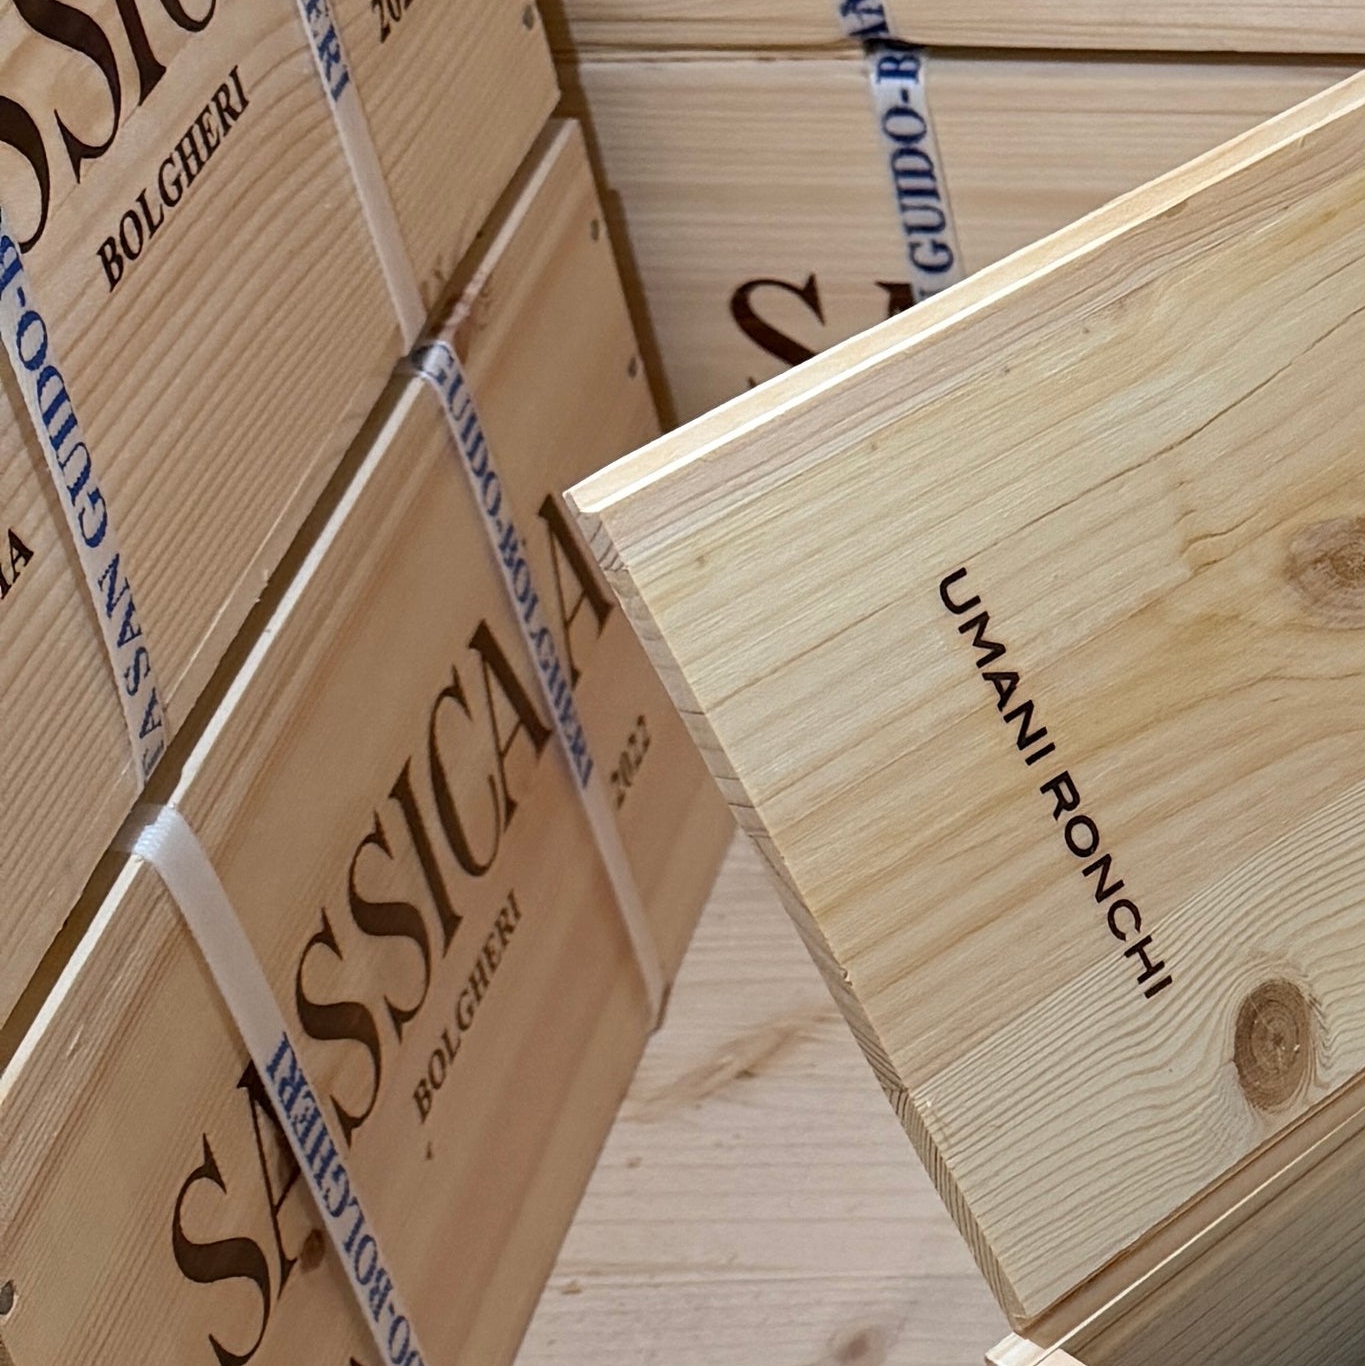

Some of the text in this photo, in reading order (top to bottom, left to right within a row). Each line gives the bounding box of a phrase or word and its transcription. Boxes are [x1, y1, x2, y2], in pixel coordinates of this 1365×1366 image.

[96, 65, 251, 293] BOLGHERI
[97, 552, 152, 697] SAN
[938, 566, 1174, 1000] UMANI RONCHI
[411, 888, 522, 1125] BOLGHERI
